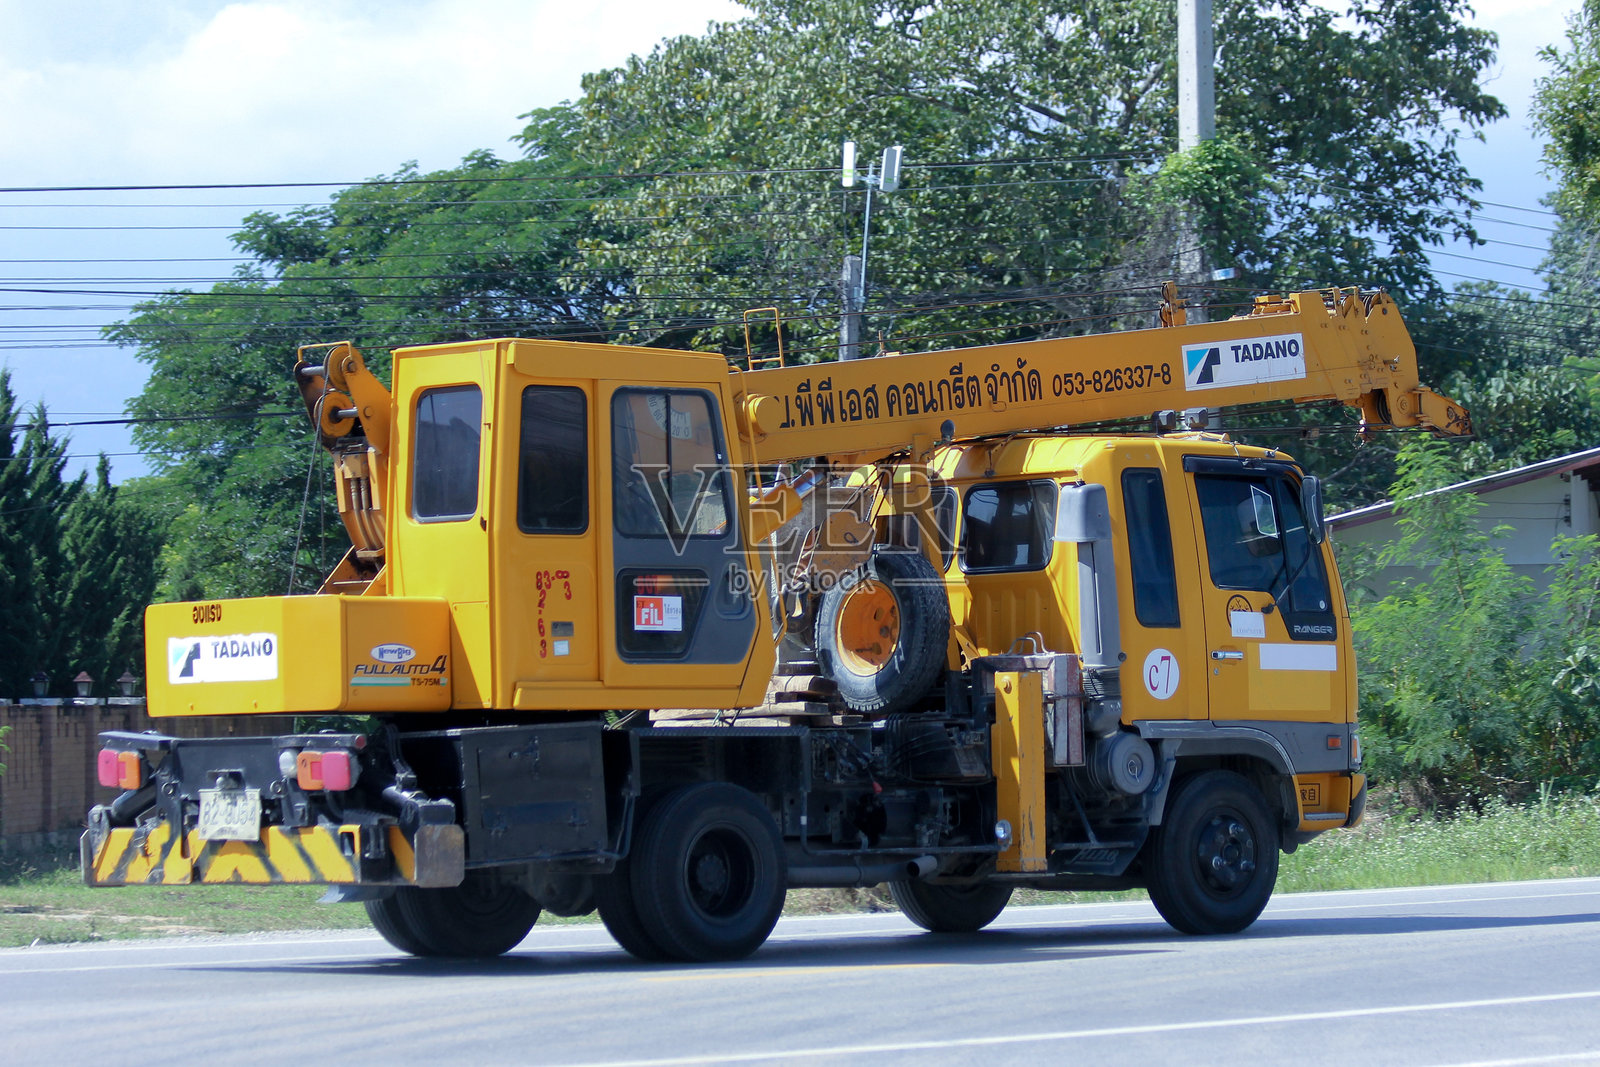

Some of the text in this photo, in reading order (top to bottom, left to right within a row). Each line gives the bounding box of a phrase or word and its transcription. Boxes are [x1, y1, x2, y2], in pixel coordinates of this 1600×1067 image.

[1231, 339, 1300, 363] TADANO
[1052, 362, 1172, 397] 053-826337-8
[1293, 625, 1333, 634] RANGER
[211, 638, 274, 660] TADANO
[410, 677, 441, 686] TS-75M
